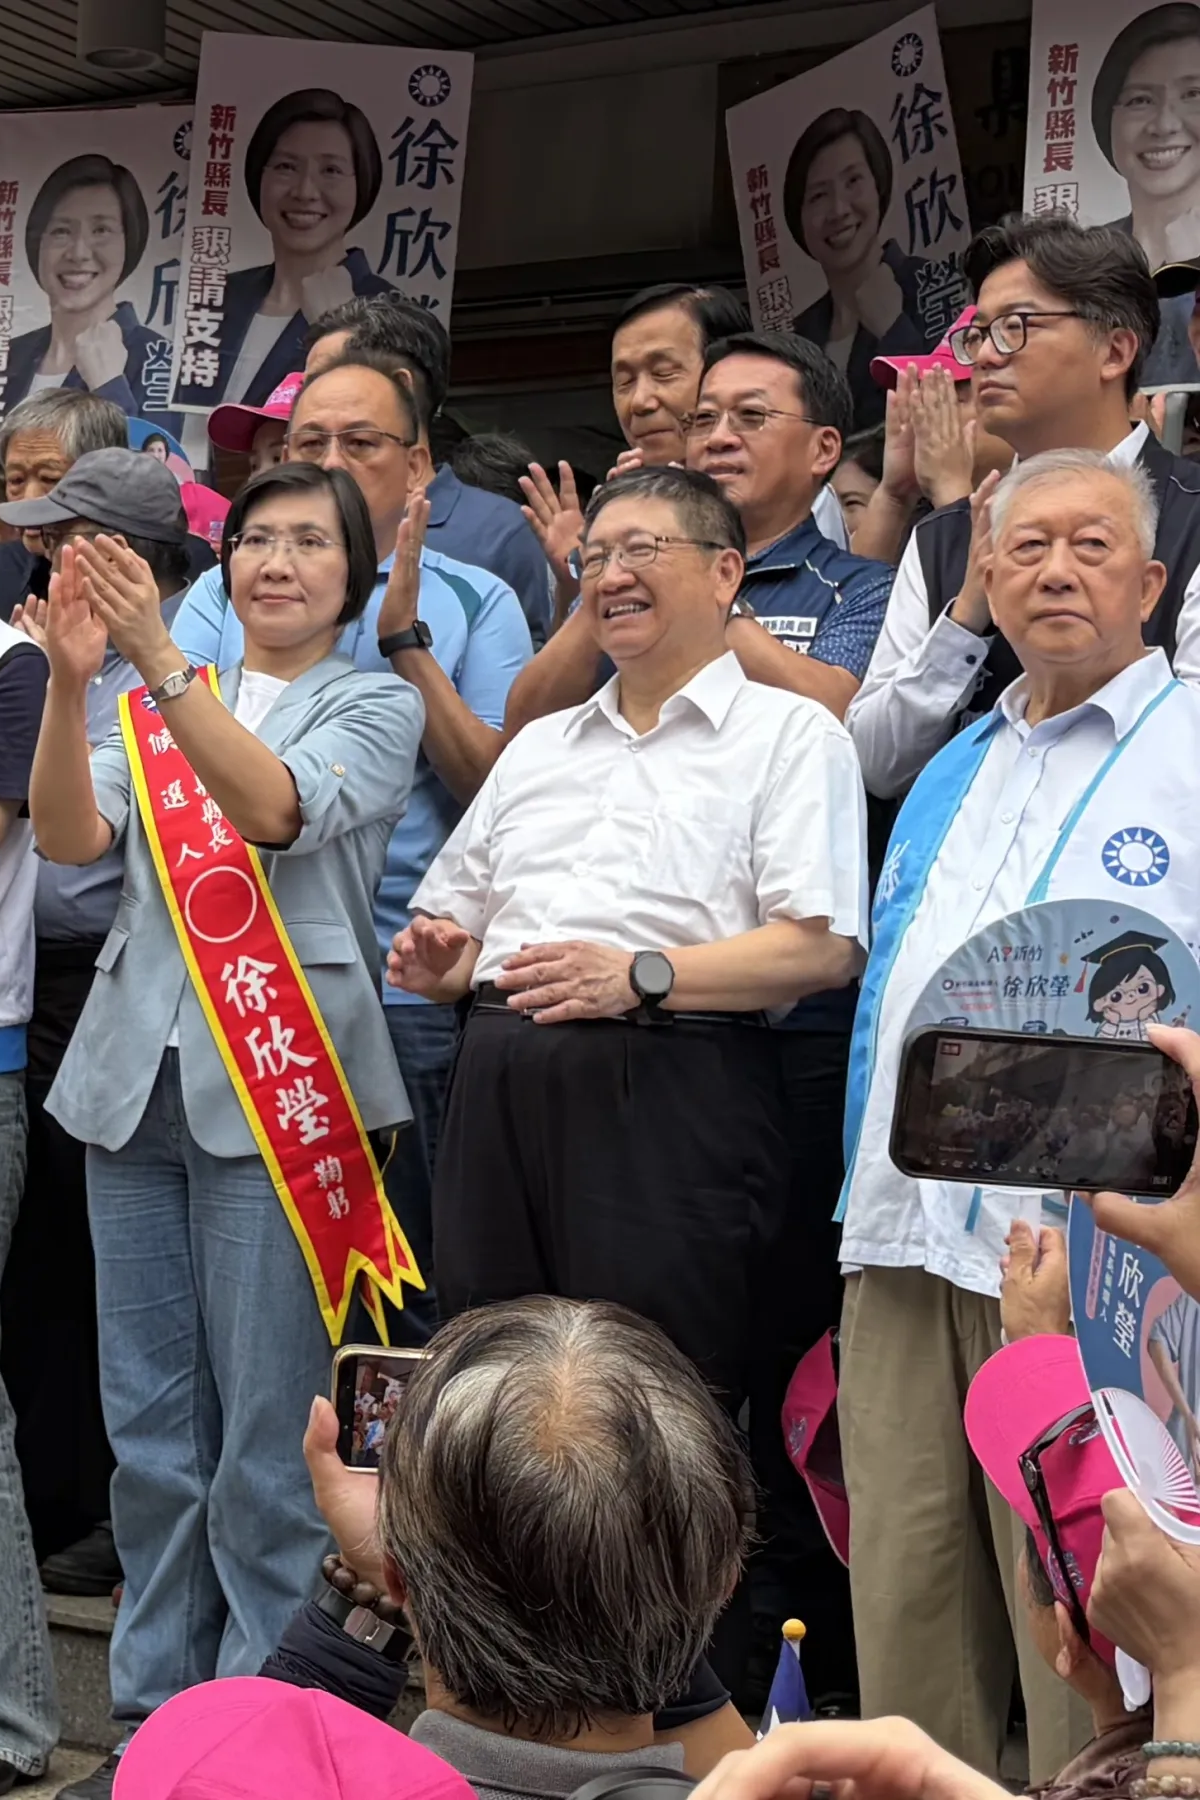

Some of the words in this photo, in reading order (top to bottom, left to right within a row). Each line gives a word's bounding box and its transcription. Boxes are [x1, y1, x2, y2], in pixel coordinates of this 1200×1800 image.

[201, 104, 236, 217] 新竹縣長
[1043, 43, 1079, 173] 新竹縣長
[377, 115, 460, 309] 徐欣
[746, 164, 781, 274] 新竹縣長
[180, 226, 231, 387] 懇請支持
[147, 727, 204, 868] 候選人
[1003, 974, 1071, 998] 徐欣瑩
[220, 955, 330, 1146] 徐欣瑩
[313, 1154, 352, 1220] 鞠躬
[1113, 1243, 1146, 1359] 欣瑩
